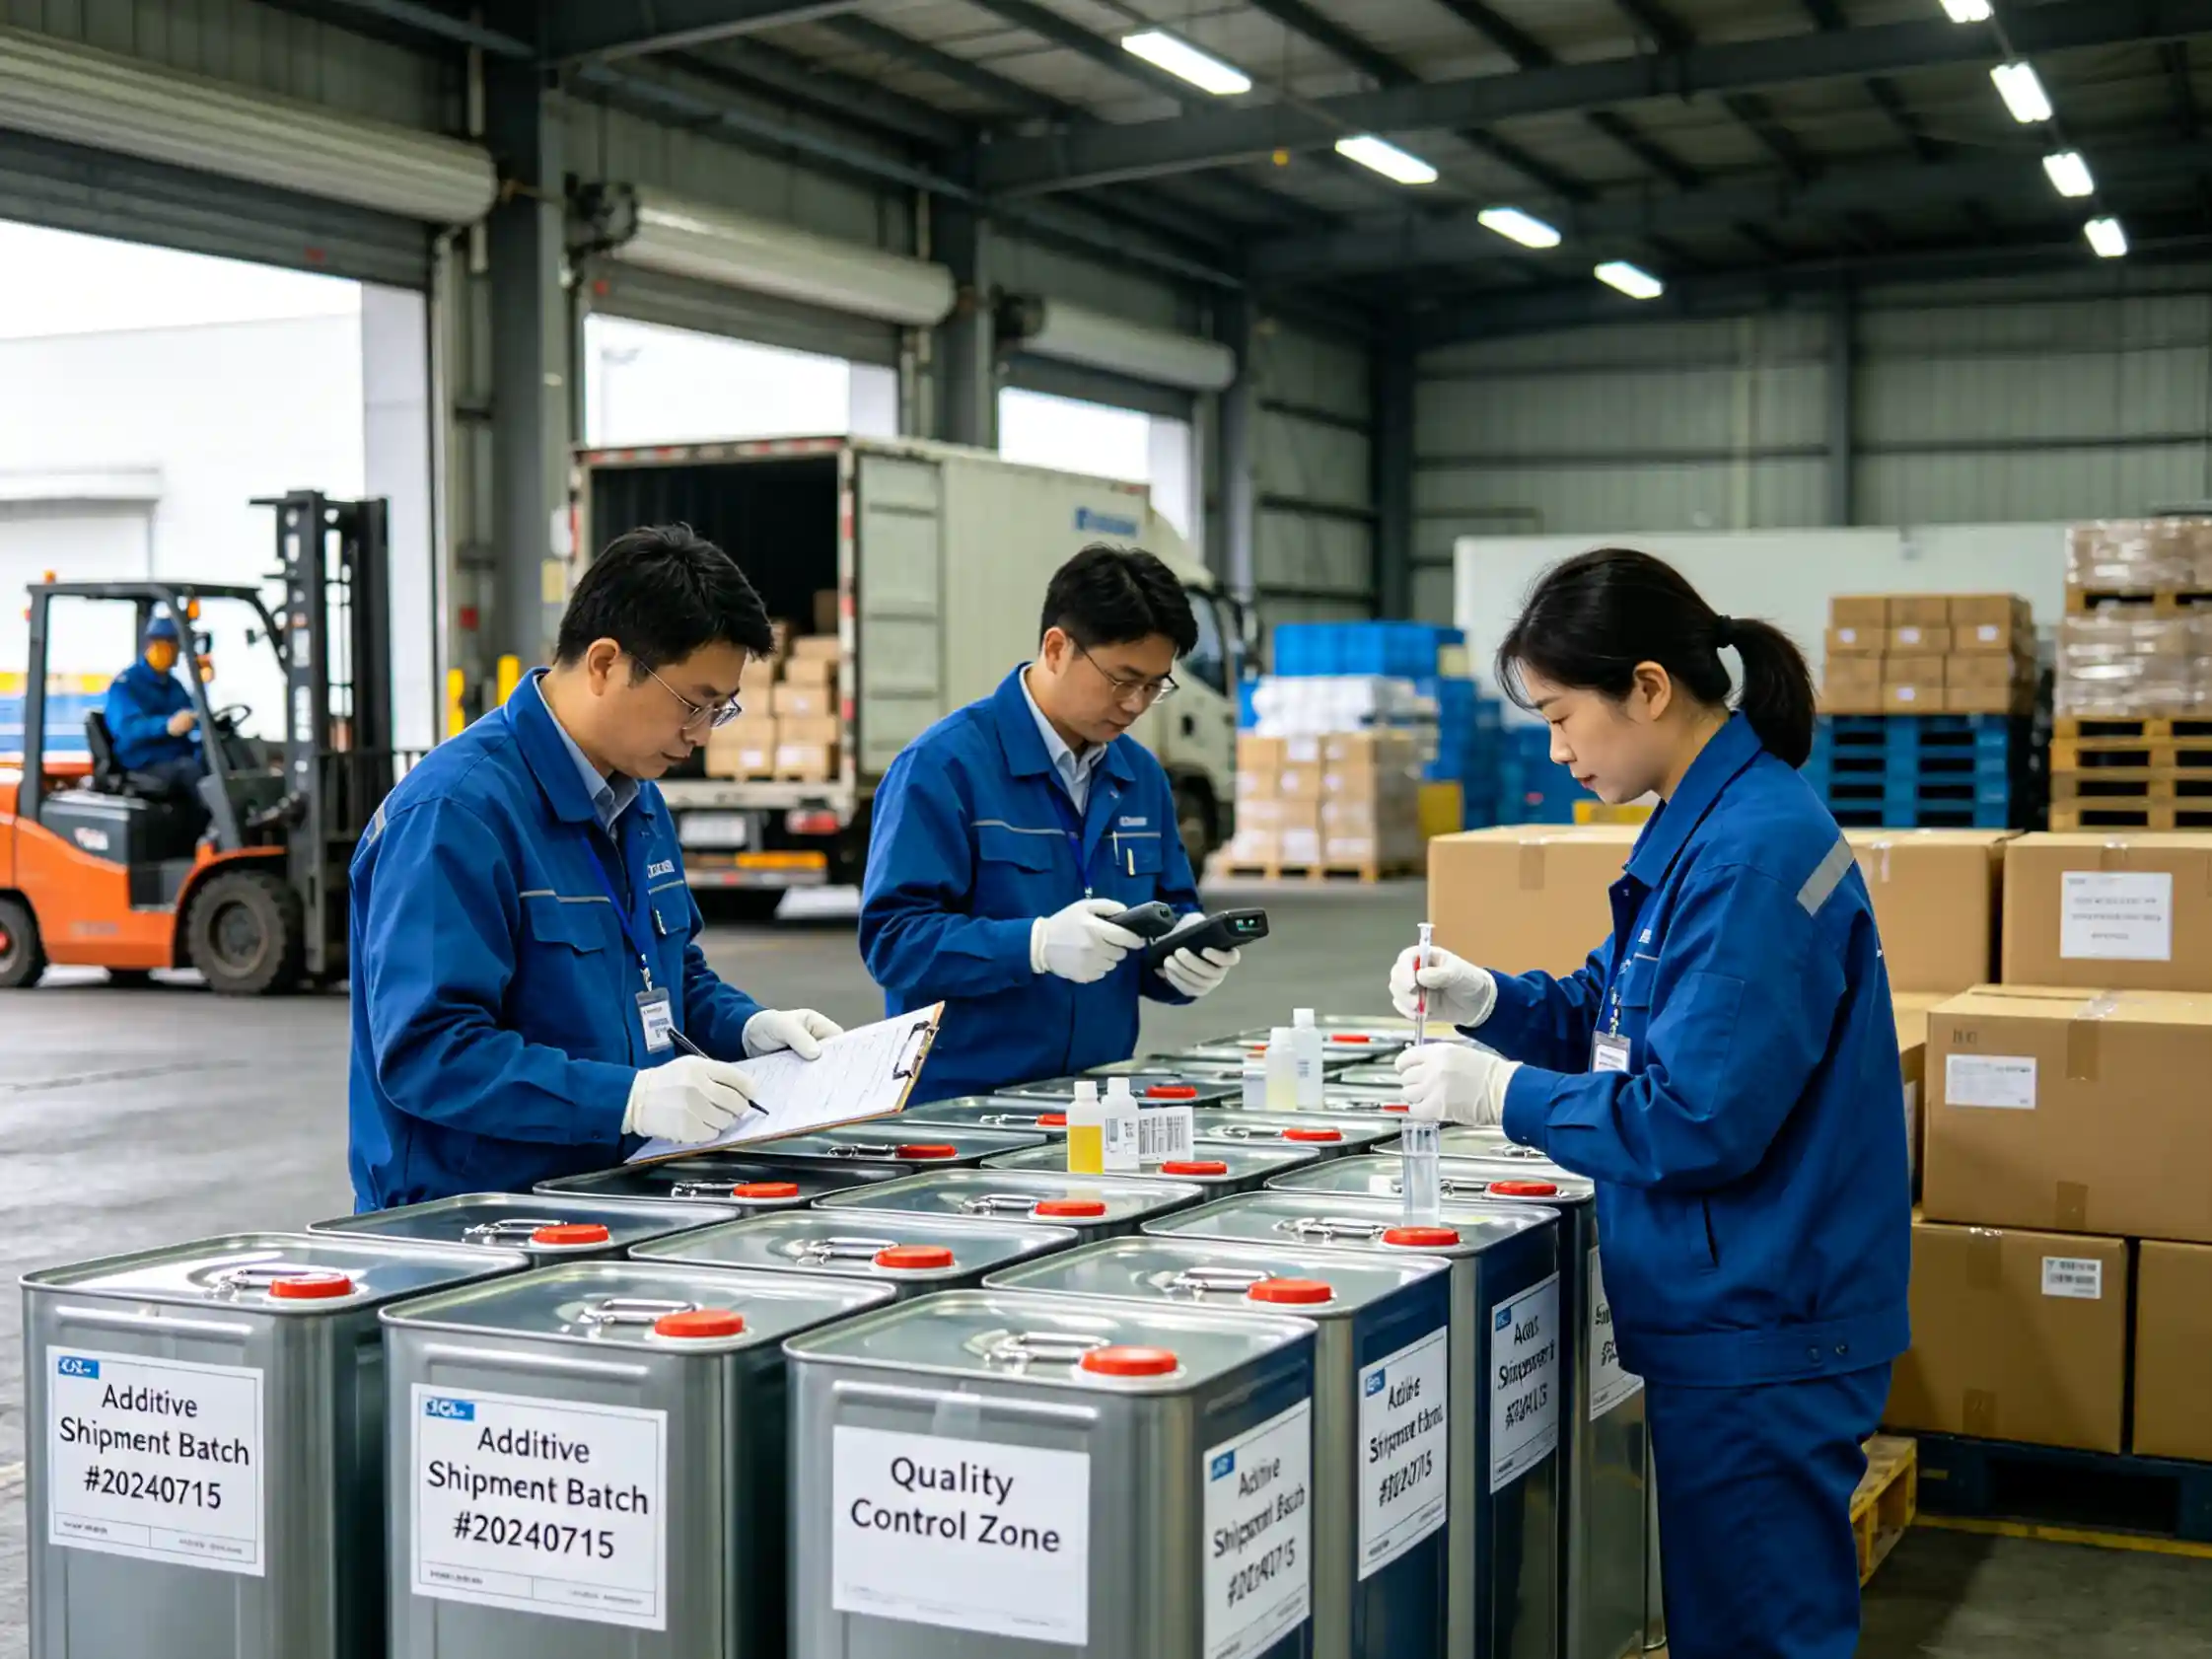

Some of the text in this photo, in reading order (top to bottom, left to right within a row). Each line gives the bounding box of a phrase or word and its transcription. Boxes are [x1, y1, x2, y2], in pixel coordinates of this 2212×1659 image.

[102, 1384, 198, 1418] Additive
[59, 1416, 250, 1466] Shipment Batch
[477, 1426, 591, 1465] Additive
[84, 1466, 222, 1510] #20240715
[427, 1460, 649, 1515] Shipment Batch
[891, 1457, 1014, 1506] Quality
[454, 1511, 614, 1559] #20240715
[851, 1498, 1061, 1553] Control Zone
